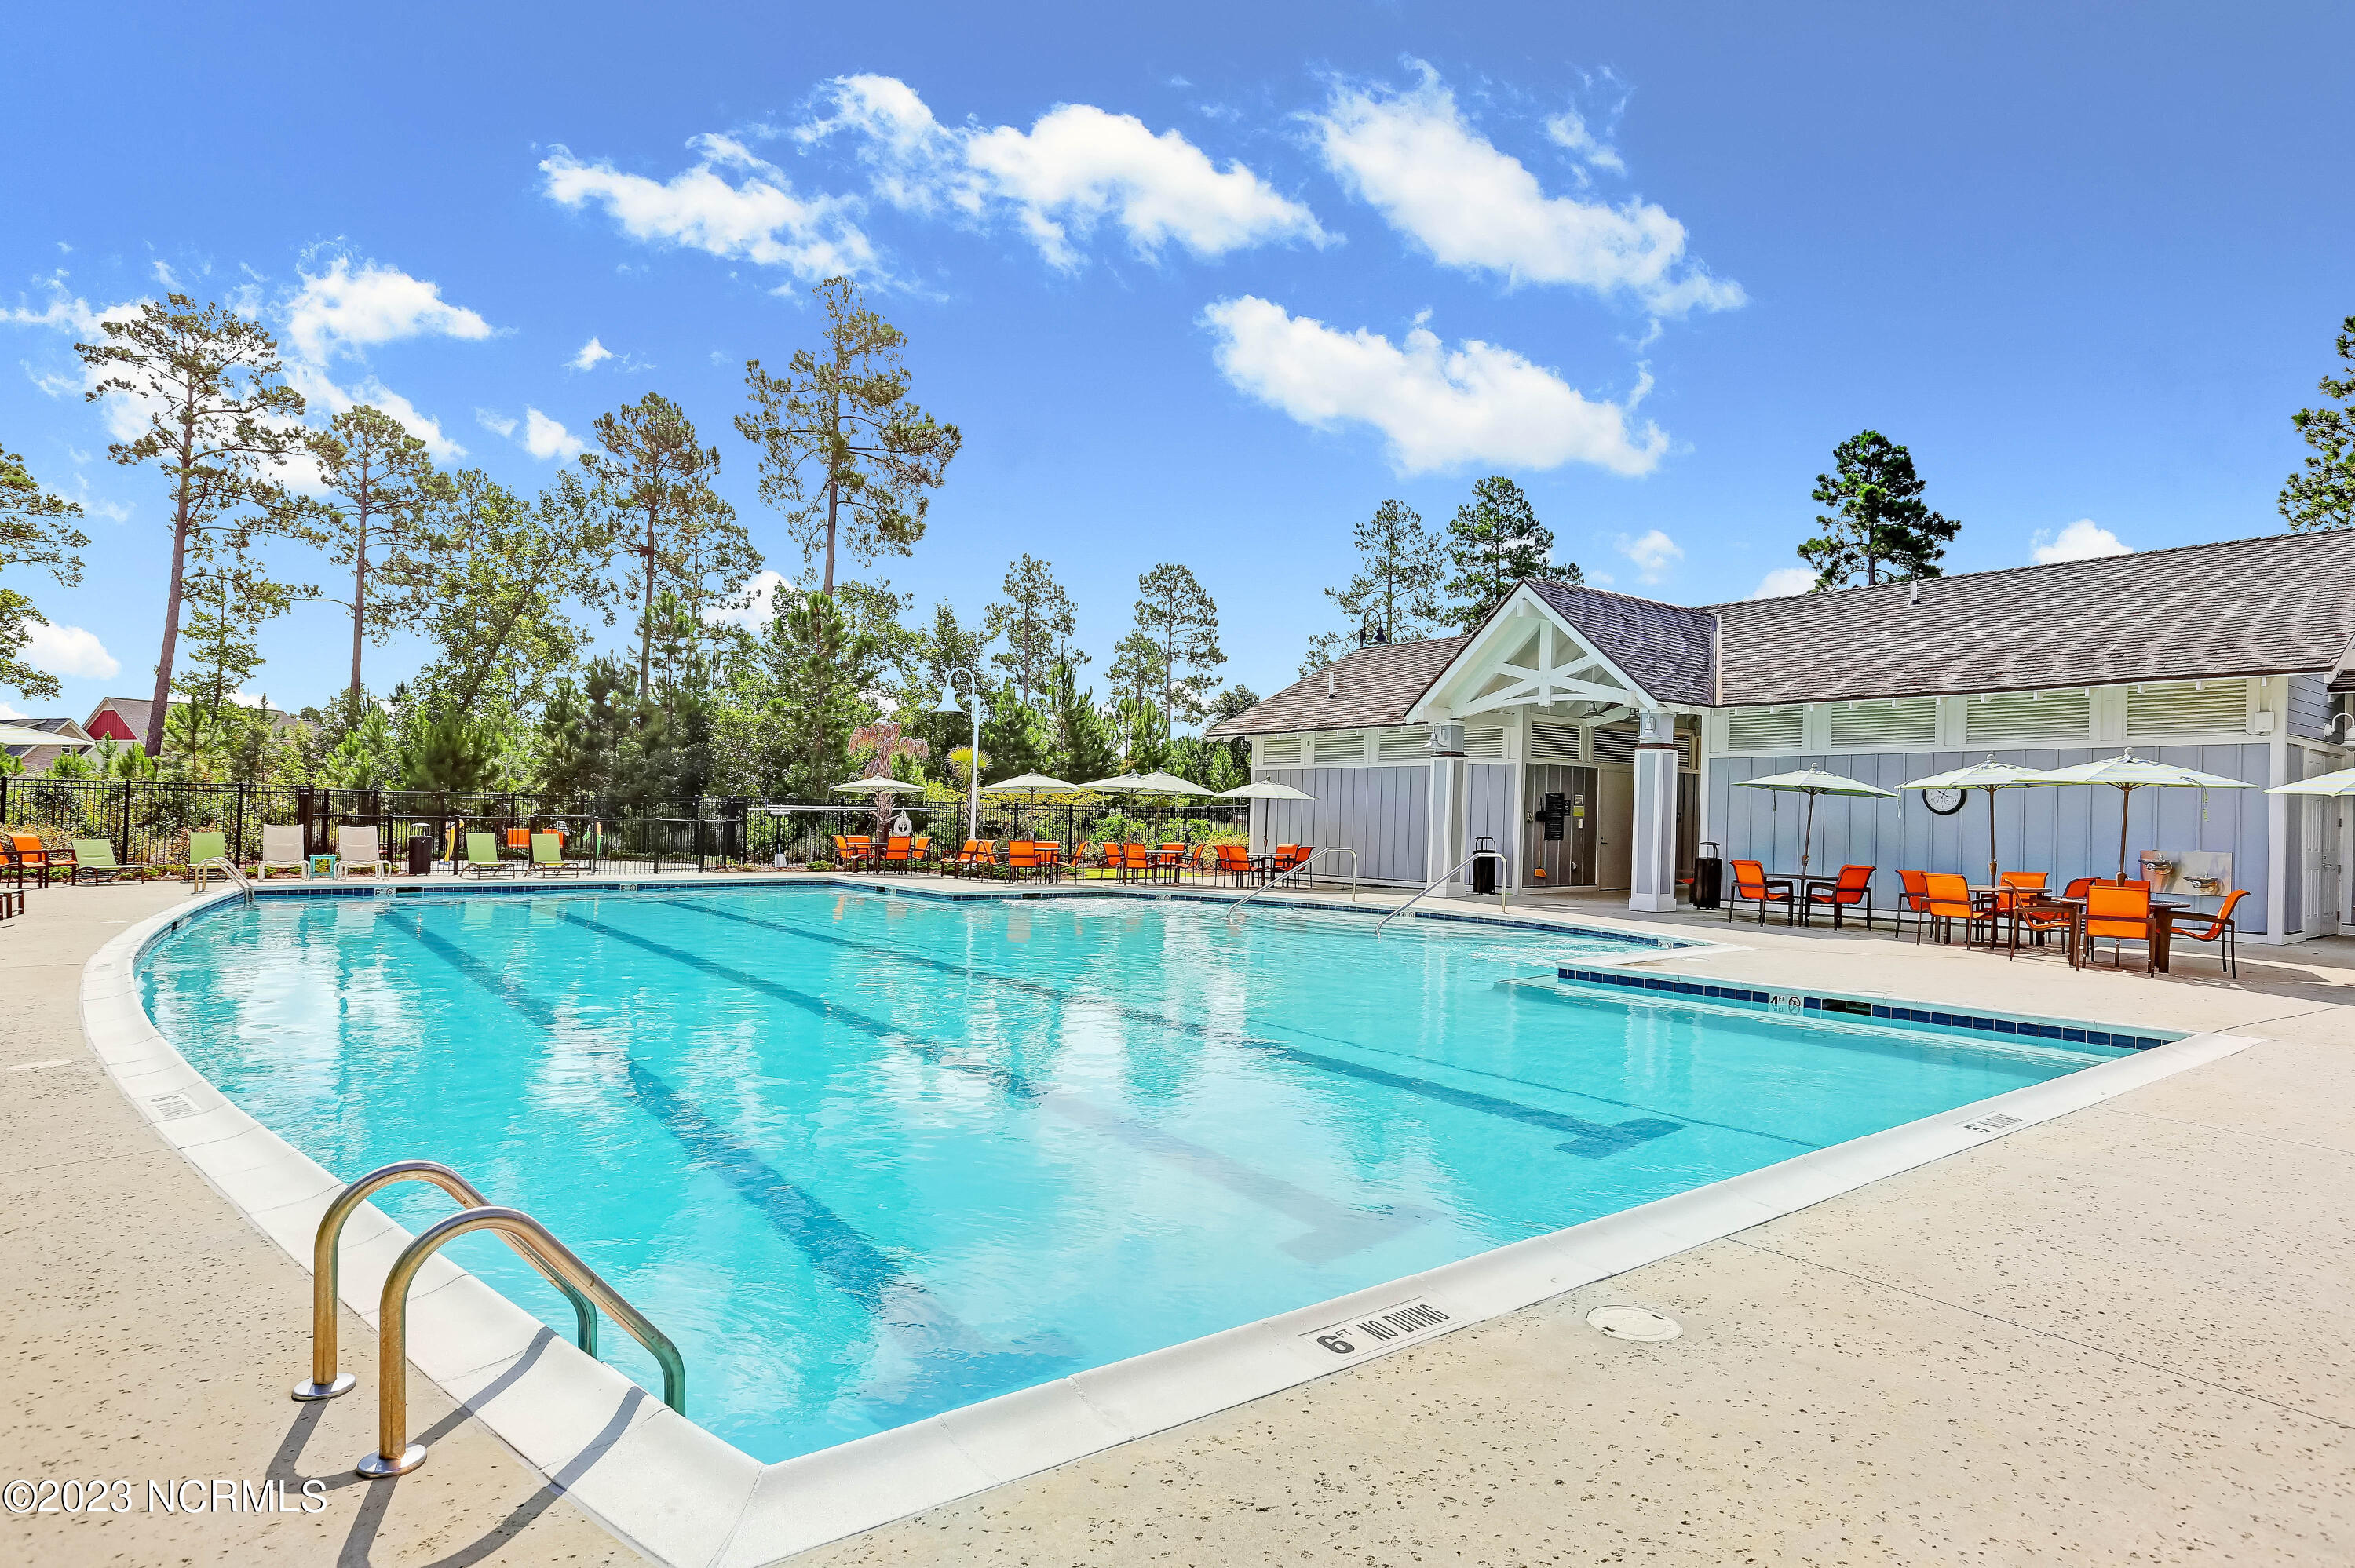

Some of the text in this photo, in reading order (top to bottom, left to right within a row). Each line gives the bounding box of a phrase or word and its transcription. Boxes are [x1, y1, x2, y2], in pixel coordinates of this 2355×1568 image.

[1316, 1304, 1451, 1354] 6 FT NO DIVING
